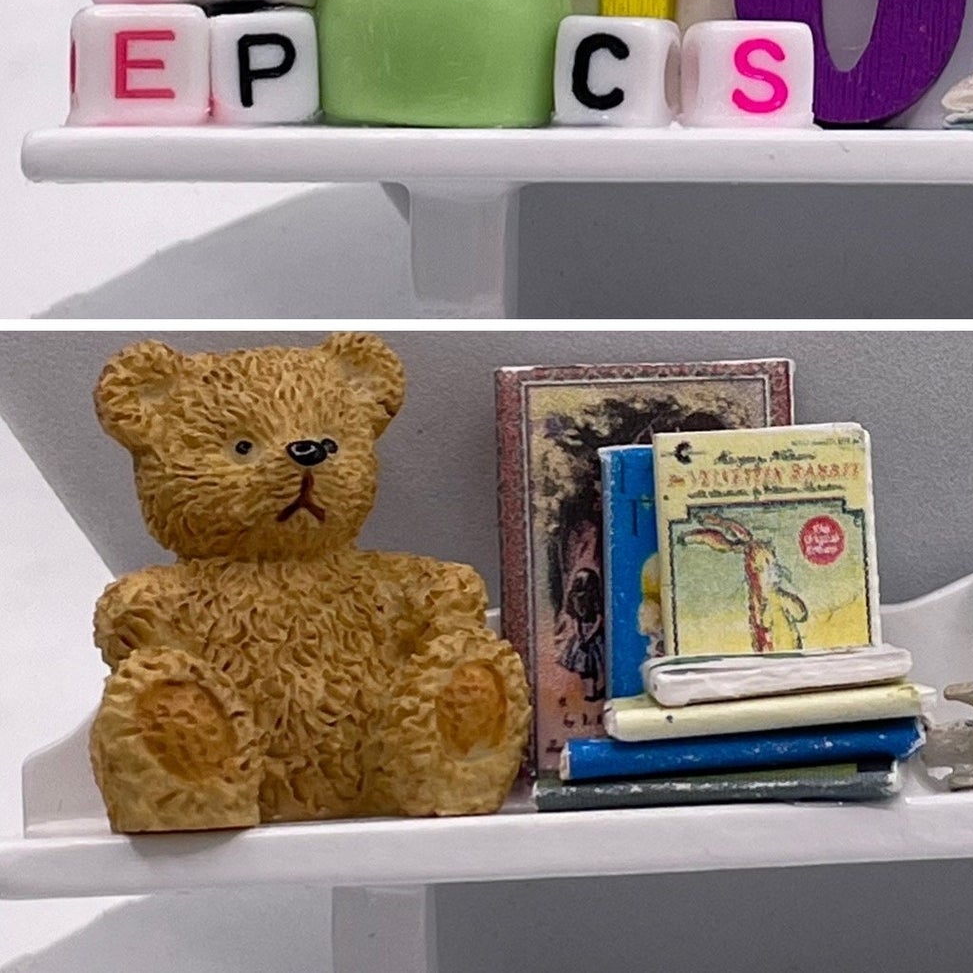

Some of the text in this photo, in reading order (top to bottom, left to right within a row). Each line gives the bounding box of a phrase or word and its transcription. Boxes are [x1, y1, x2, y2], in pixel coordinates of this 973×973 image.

[113, 29, 177, 100] E
[236, 32, 298, 109] P
[571, 31, 630, 110] C
[731, 38, 789, 114] S
